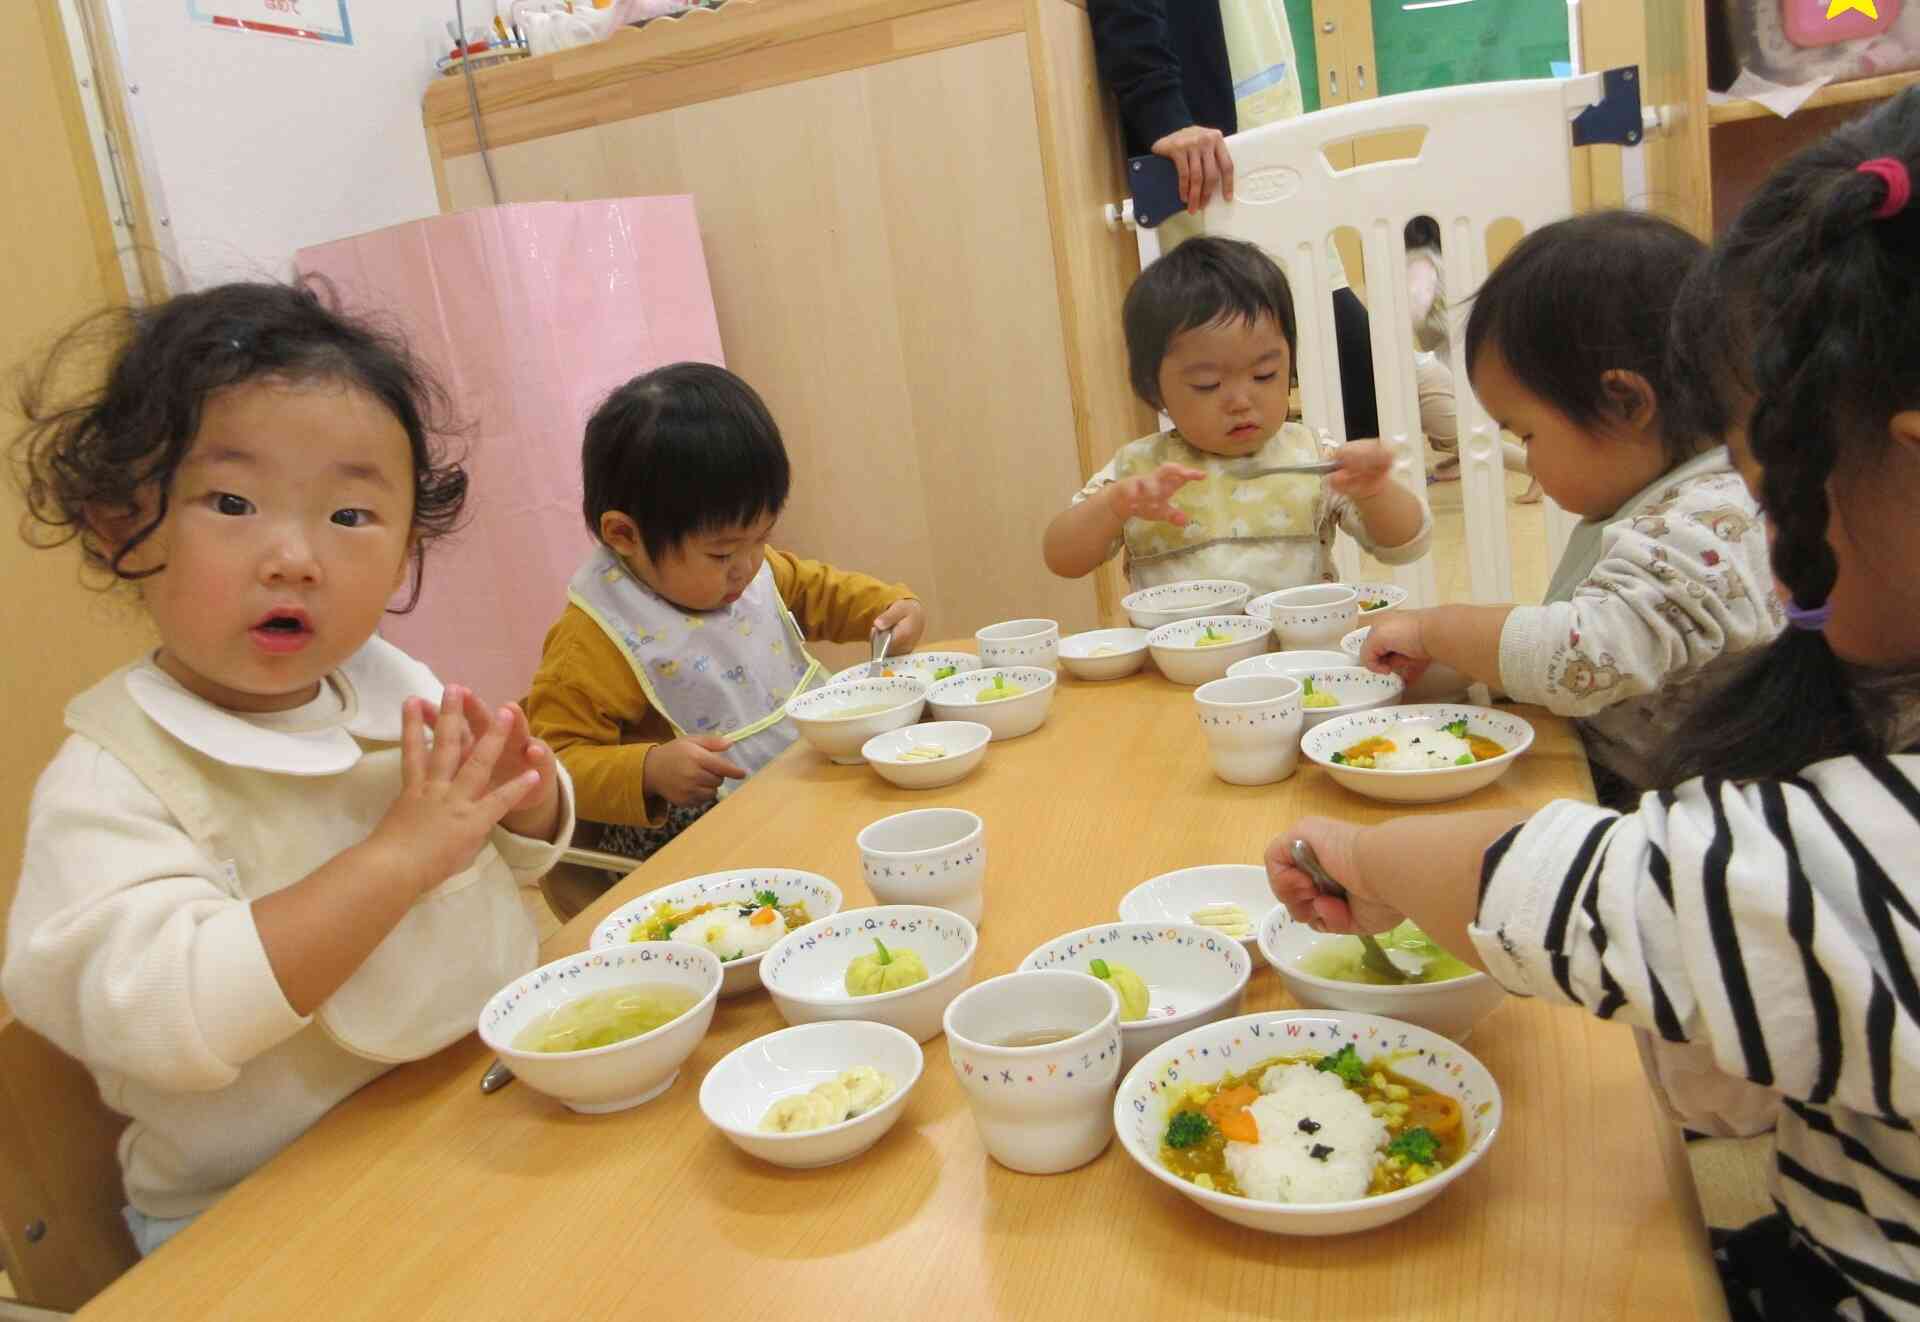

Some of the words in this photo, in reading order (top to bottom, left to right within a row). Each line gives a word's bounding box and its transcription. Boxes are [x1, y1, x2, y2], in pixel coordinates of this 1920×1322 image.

[864, 918, 877, 930] Q
[1205, 937, 1216, 951] Q
[640, 950, 653, 962] Q
[1167, 1067, 1179, 1081] S
[1249, 1023, 1261, 1038] V
[1286, 1023, 1302, 1038] W
[1327, 1023, 1341, 1038] X
[1398, 1033, 1409, 1049] Z
[1000, 1069, 1014, 1085] X
